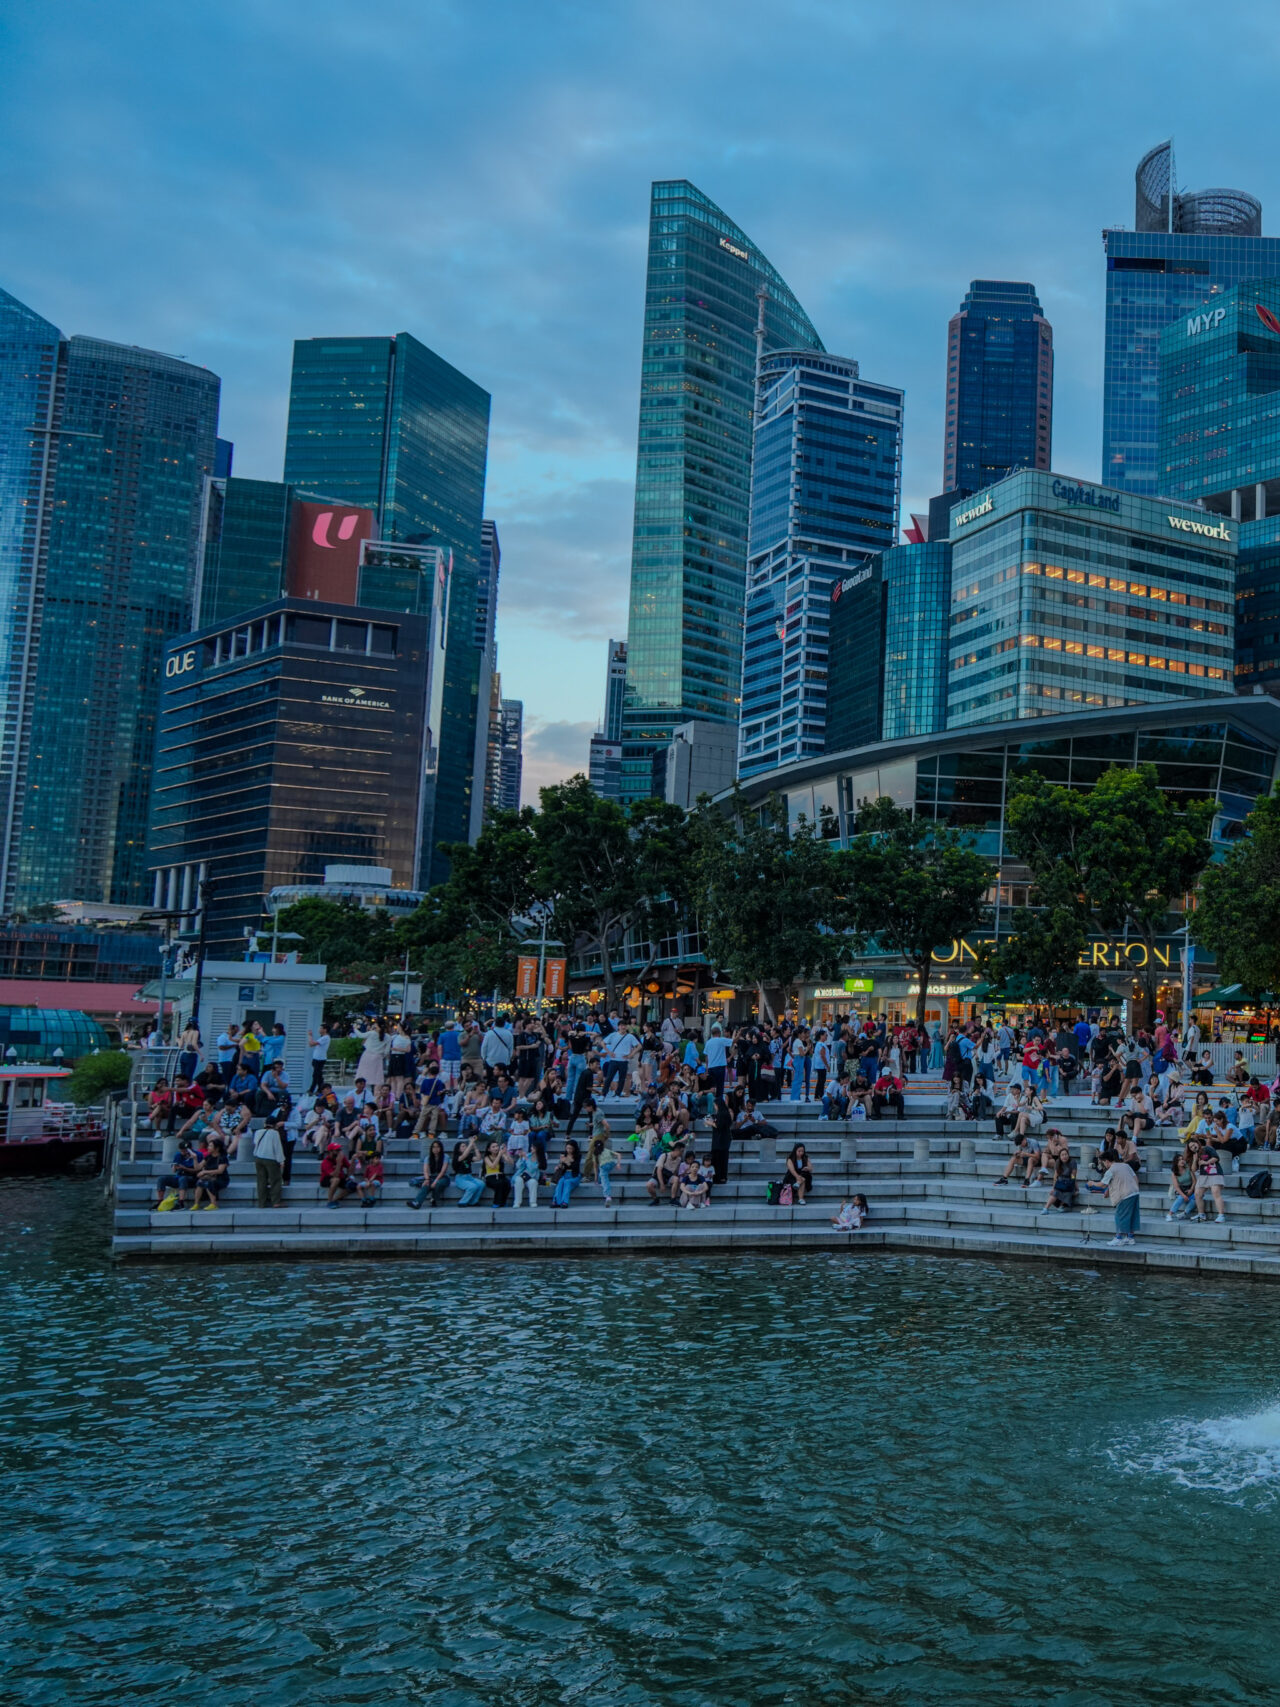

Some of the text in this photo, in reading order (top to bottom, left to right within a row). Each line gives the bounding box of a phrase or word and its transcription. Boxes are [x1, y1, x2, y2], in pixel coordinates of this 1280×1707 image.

[719, 238, 748, 260] Keppel
[1187, 308, 1226, 337] MYP
[1052, 479, 1120, 512] CapitaLand
[955, 494, 993, 528] wework
[1168, 516, 1231, 541] wework
[166, 650, 196, 677] OUE
[321, 695, 343, 703] BANK
[355, 699, 390, 708] AMERICA
